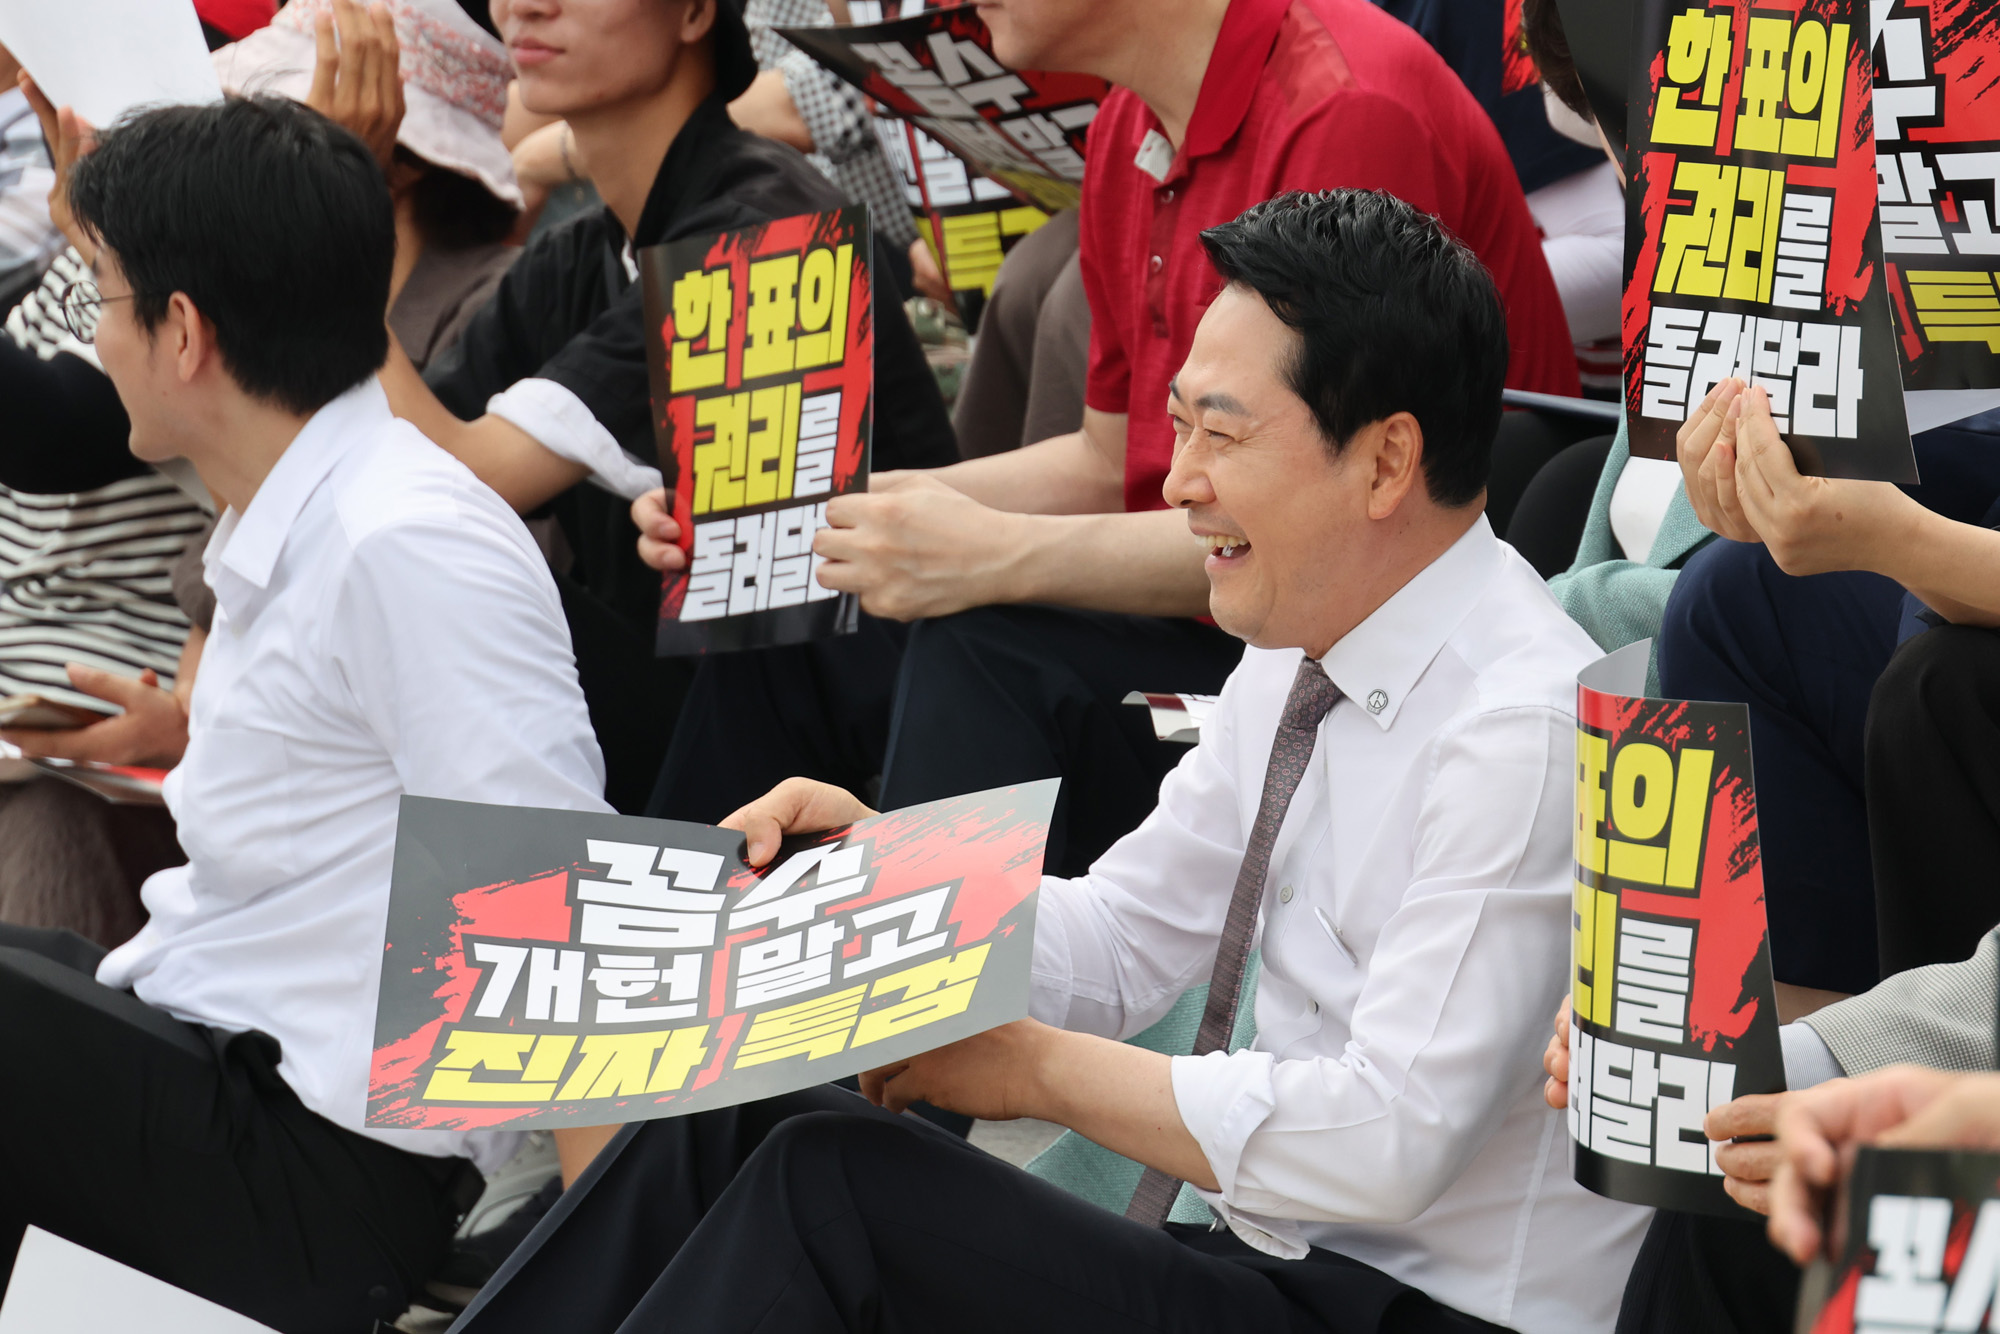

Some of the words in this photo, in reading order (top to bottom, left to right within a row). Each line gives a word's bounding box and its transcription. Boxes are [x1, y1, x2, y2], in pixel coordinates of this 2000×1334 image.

[1650, 8, 1732, 147] 한
[1734, 16, 1851, 158] 표의
[1653, 161, 1832, 311] 권리를
[671, 270, 732, 393] 한
[743, 243, 854, 380] 표의
[1905, 270, 2000, 354] 특
[693, 382, 841, 515] 권리를
[472, 942, 703, 1024] 개헌
[734, 886, 952, 1010] 말고
[576, 838, 869, 949] 꼼수
[422, 1024, 711, 1101] 진짜
[733, 942, 993, 1070] 특검
